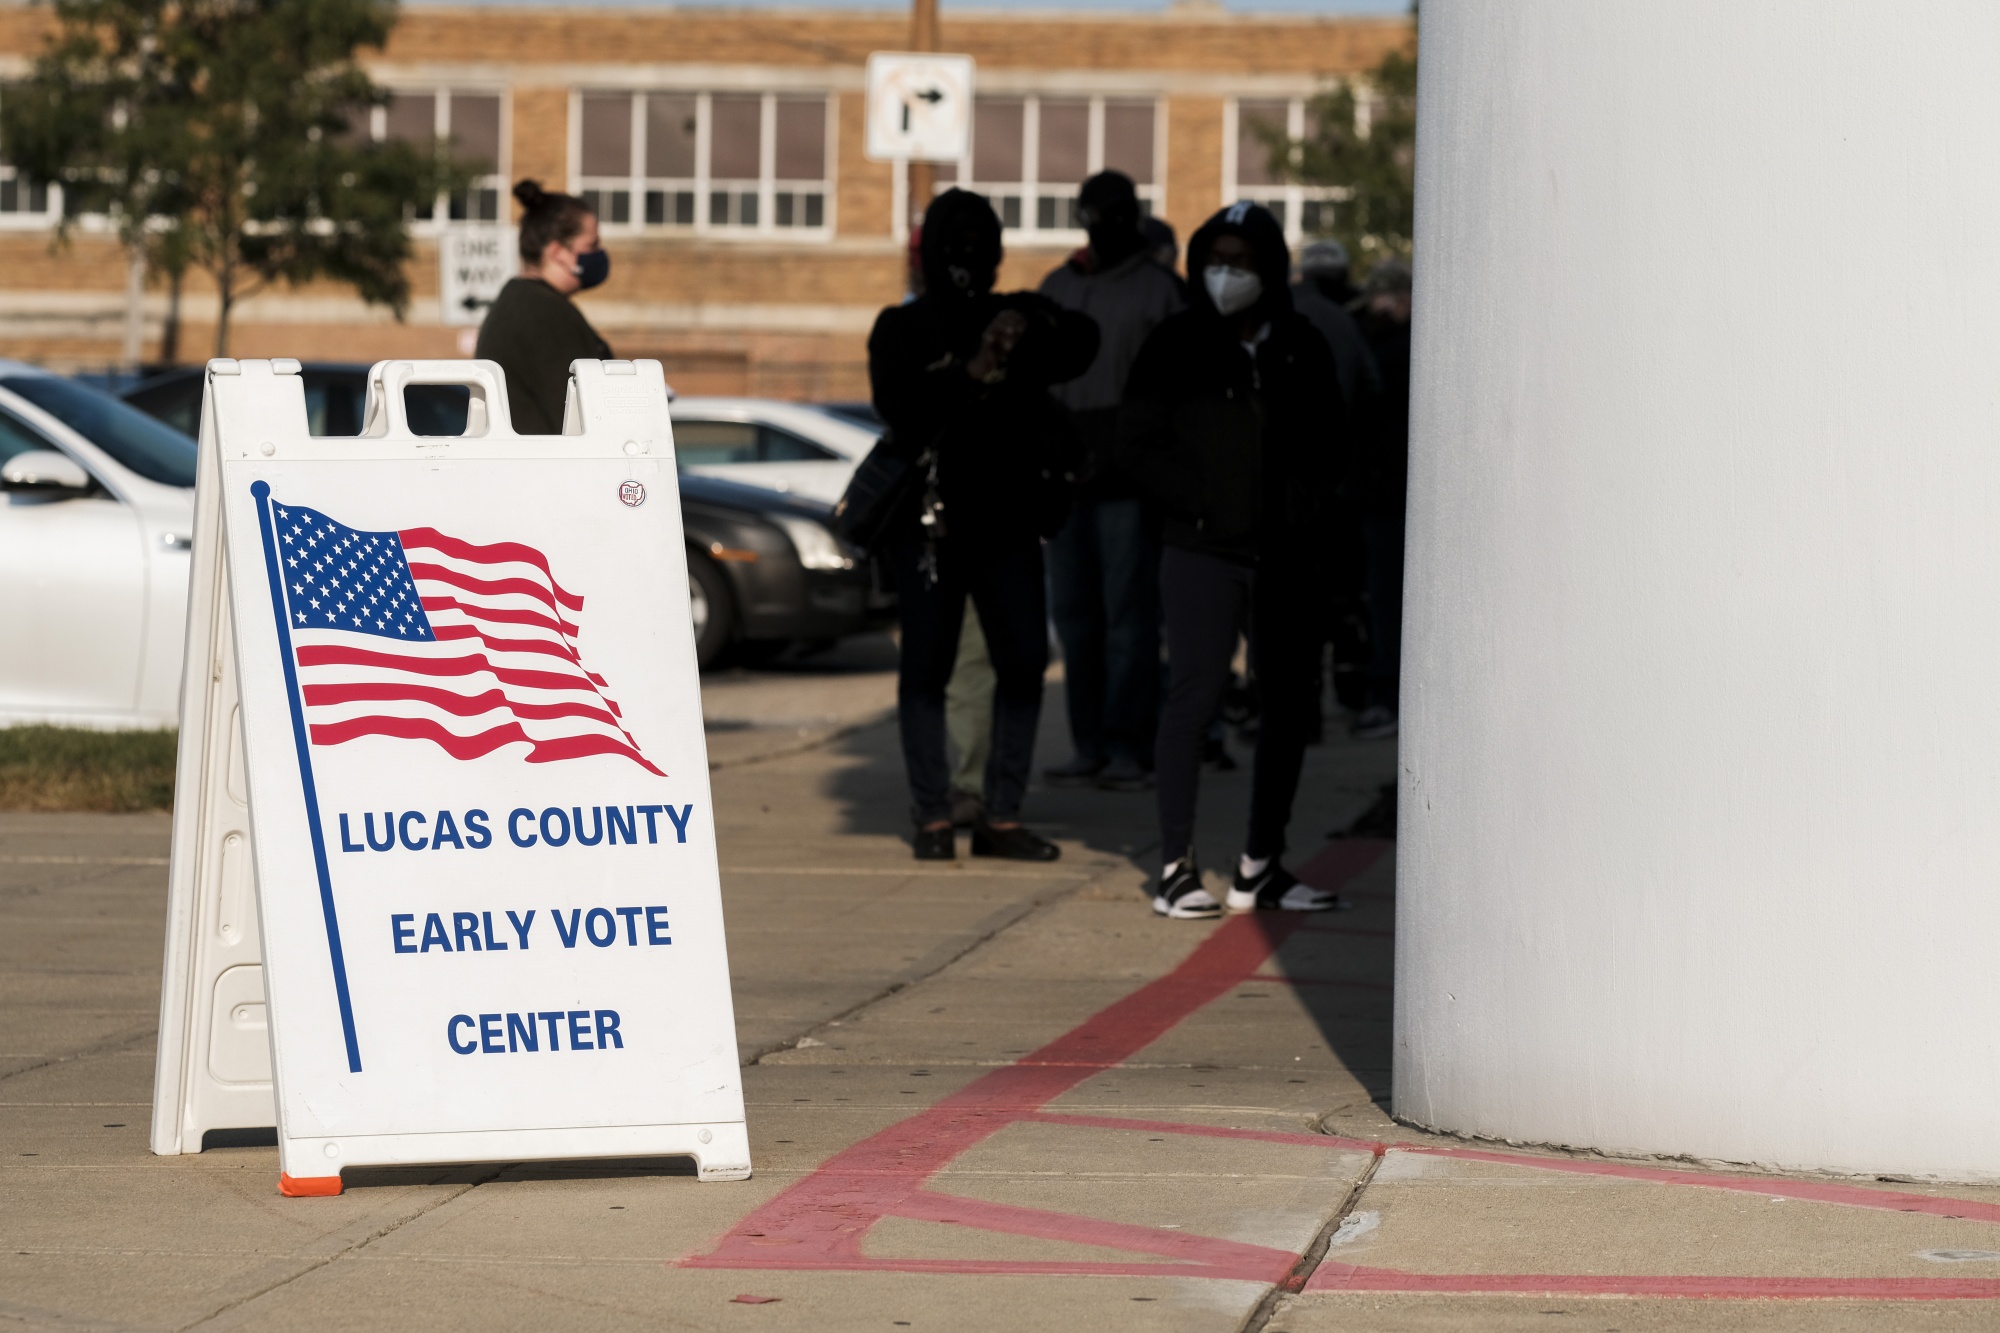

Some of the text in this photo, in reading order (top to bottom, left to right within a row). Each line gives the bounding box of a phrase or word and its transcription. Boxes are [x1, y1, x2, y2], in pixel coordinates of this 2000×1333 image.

[340, 804, 692, 852] LUCAS COUNTY
[392, 906, 672, 953] EARLY VOTE
[448, 1010, 623, 1054] CENTER
